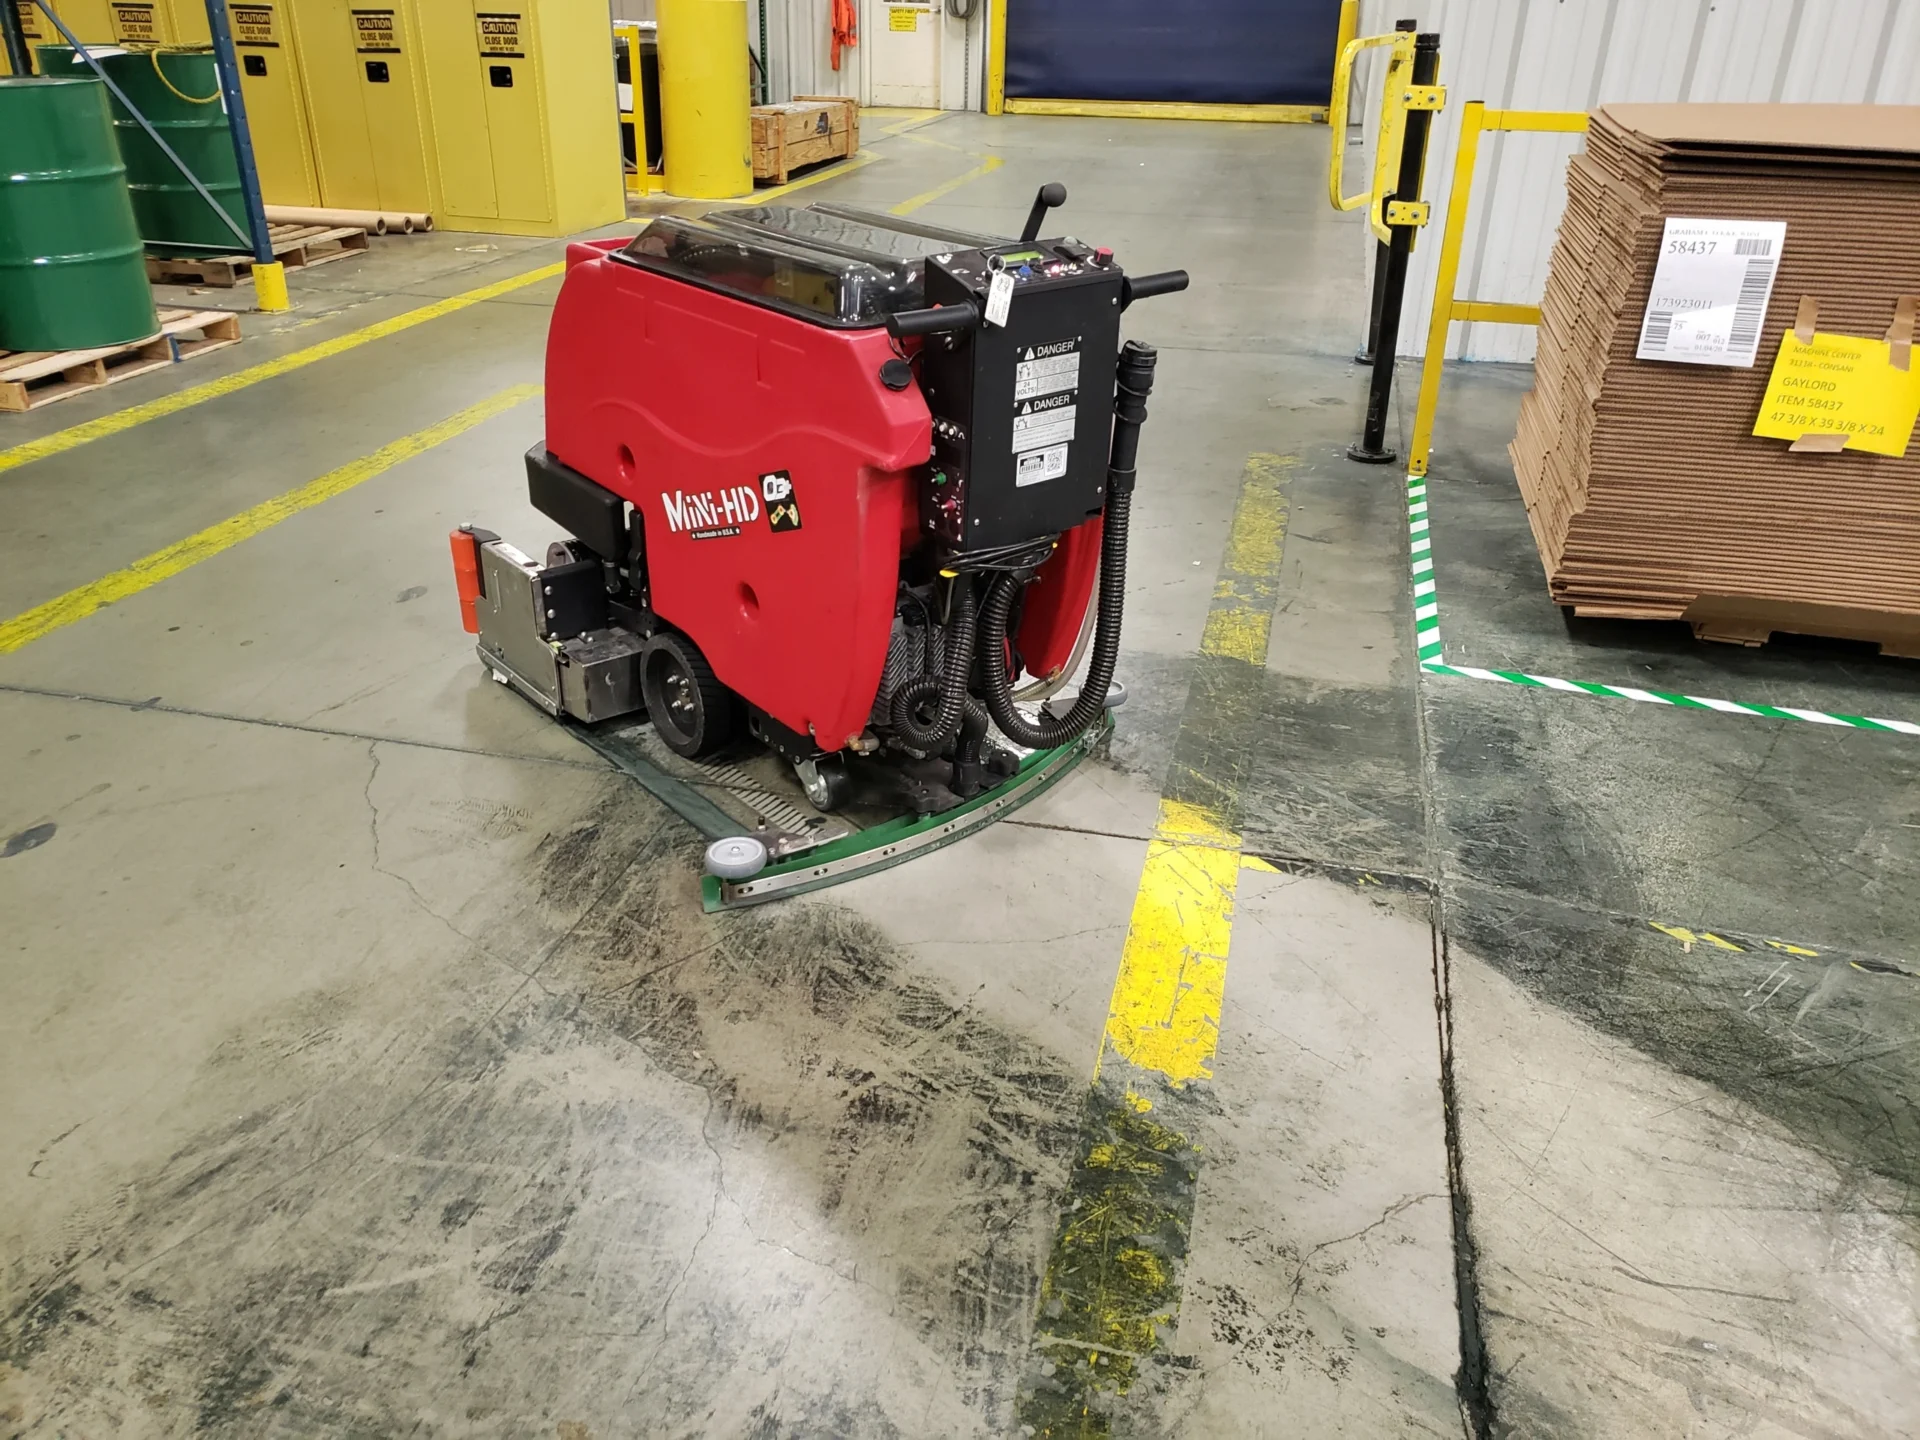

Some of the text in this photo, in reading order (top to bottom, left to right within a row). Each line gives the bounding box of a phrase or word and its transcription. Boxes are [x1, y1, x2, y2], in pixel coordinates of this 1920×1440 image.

[120, 11, 151, 21] CAUTION
[237, 13, 270, 23] CAUTION
[122, 24, 138, 32] CLOSE
[358, 19, 391, 29] CAUTION
[483, 23, 517, 33] CAUTION
[239, 25, 271, 35] CLOSE DOOR
[360, 32, 393, 41] CLOSE DOOR
[485, 36, 518, 45] CLOSE DOOR
[1668, 240, 1717, 255] 58437
[1655, 297, 1713, 310] 173923011
[1674, 322, 1684, 331] 75
[1696, 333, 1711, 341] 007
[1037, 341, 1074, 357] DANGER
[1793, 346, 1862, 360] MACHINE CENTER
[1782, 377, 1836, 392] GAYLORD
[1034, 394, 1070, 411] DANGER
[1776, 394, 1843, 412] ITEM 58437
[1771, 411, 1885, 436] 47 3/8 X 39 3/8 X 24
